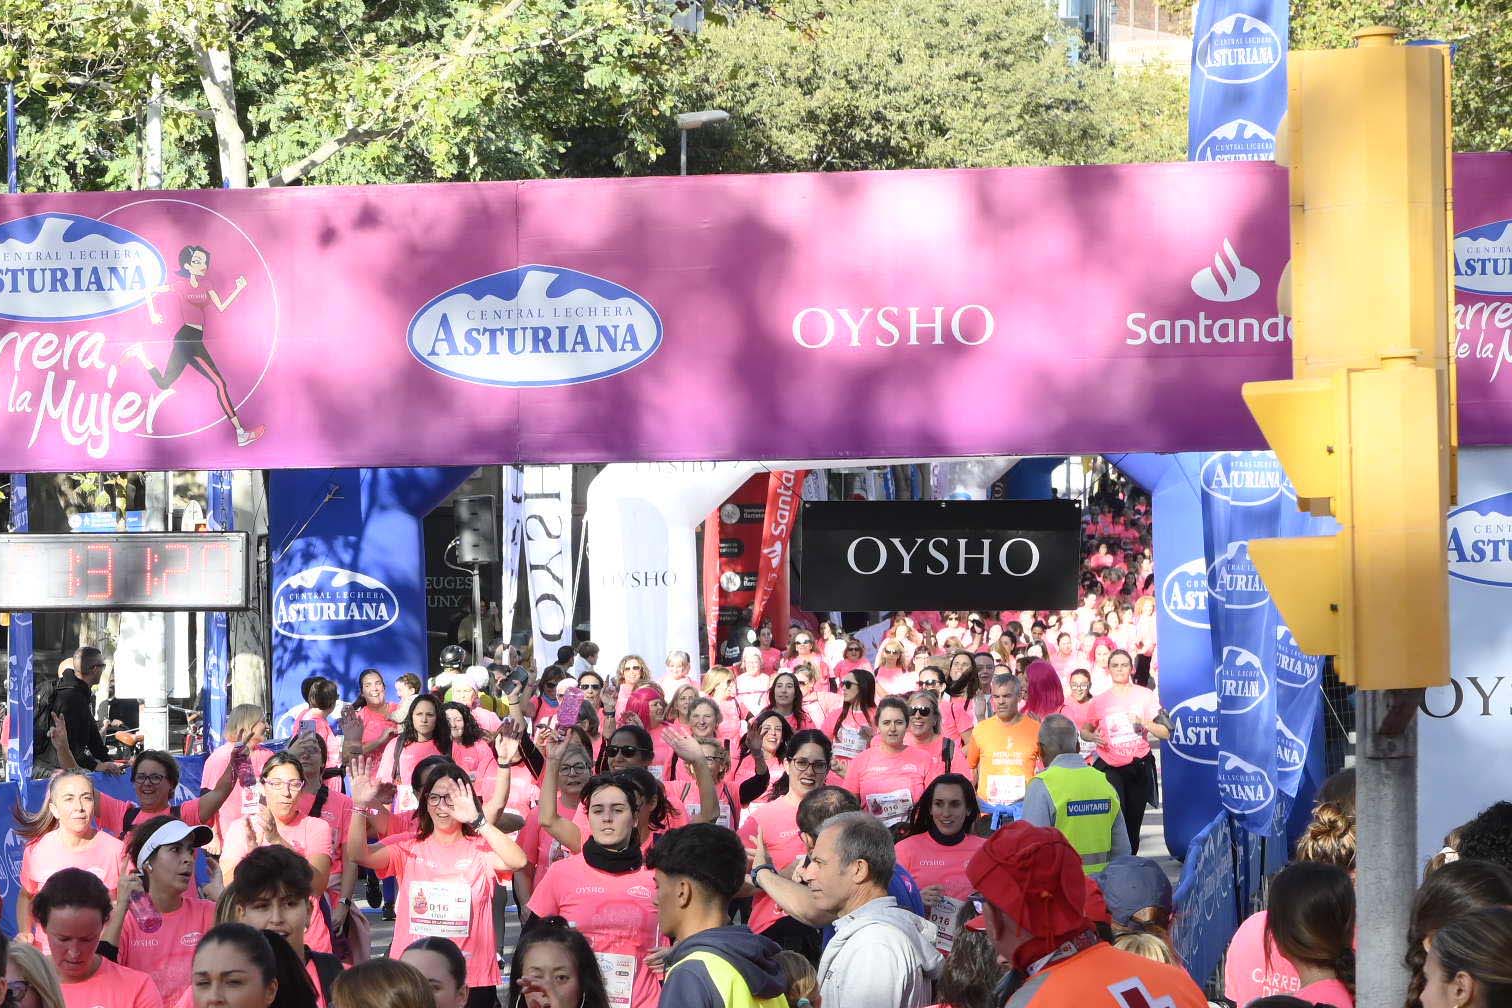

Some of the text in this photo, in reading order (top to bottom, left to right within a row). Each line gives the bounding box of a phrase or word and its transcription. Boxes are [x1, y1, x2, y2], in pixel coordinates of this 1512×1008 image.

[1204, 44, 1275, 67] ASTURIANA
[70, 249, 142, 260] LECHERA
[467, 305, 634, 320] CENTRAL LECHERA
[791, 304, 995, 348] OYSHO
[1125, 312, 1294, 345] Santand
[427, 312, 642, 356] ASTURIANA
[7, 376, 32, 413] la
[27, 367, 176, 458] Mujer
[846, 536, 1041, 579] OYSHO
[276, 599, 390, 623] ASTURIANA
[1417, 676, 1512, 718] OY
